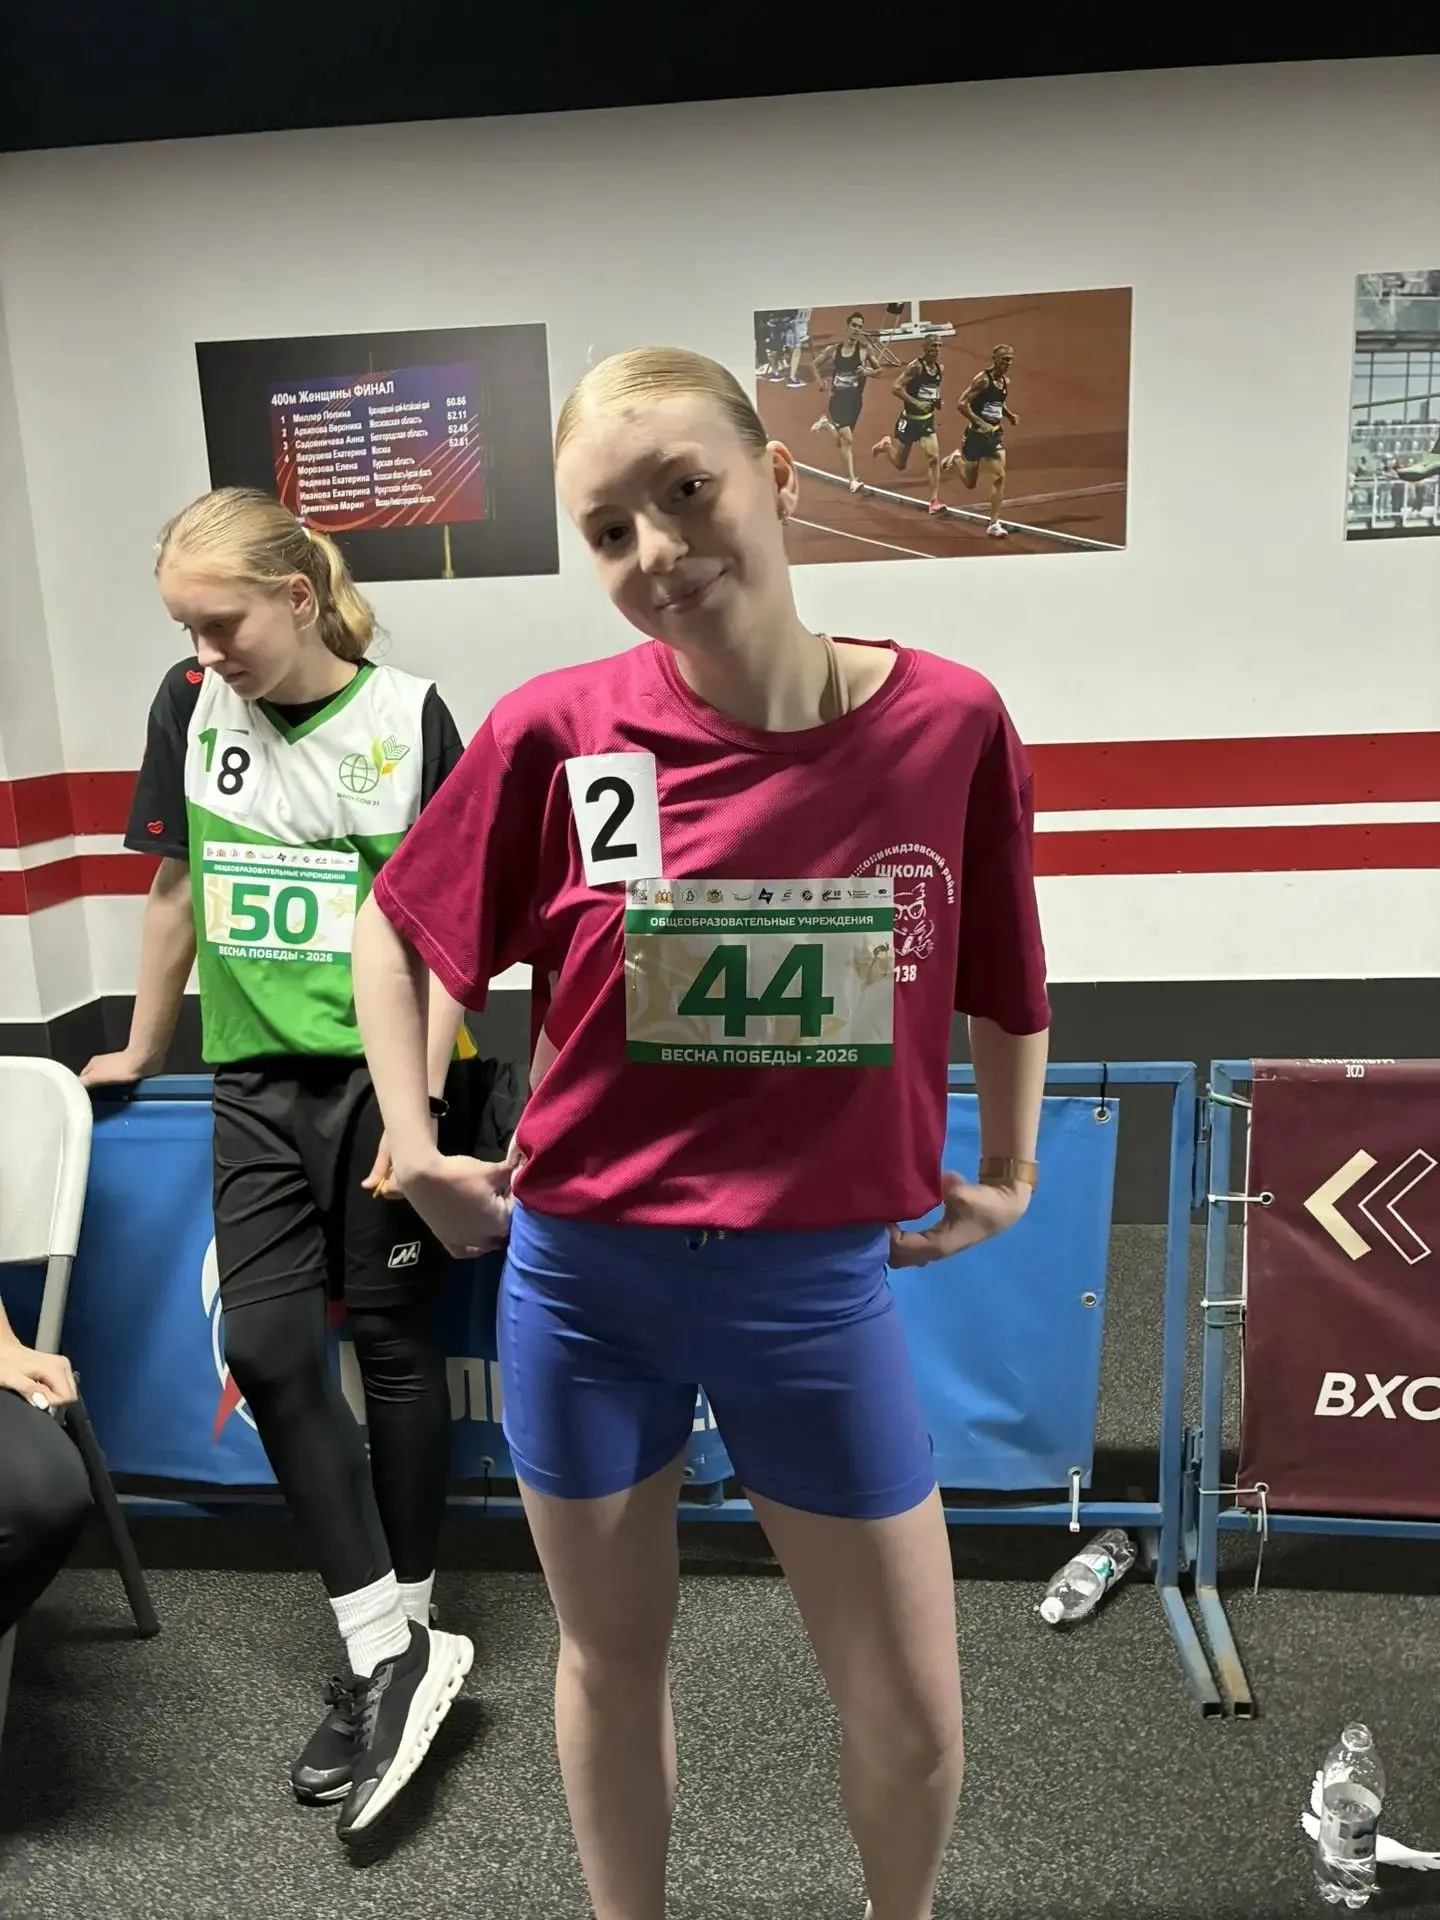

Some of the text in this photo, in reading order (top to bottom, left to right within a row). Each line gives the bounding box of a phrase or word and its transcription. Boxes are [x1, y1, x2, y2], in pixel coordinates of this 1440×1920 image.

[271, 380, 395, 407] 400м Женщины ФИНАЛ
[281, 429, 287, 438] 2
[327, 421, 362, 434] Вероника
[447, 411, 467, 421] 52.11
[292, 411, 322, 425] Миллер
[322, 408, 352, 421] Полина
[283, 442, 288, 451] 3
[284, 454, 290, 463] 4
[297, 463, 334, 477] Морозова
[335, 461, 359, 473] Елена
[332, 474, 370, 487] Екатерина
[300, 489, 331, 502] Иванова
[332, 487, 370, 500] Екатерина
[217, 746, 250, 795] 8
[585, 775, 638, 863] 2
[214, 863, 346, 881] ОБЩЕОБРАЗОВАТЕЛЬНЫЕ УЧРЕЖДЕНИЯ
[875, 864, 934, 878] ШКОЛА
[229, 882, 319, 945] 50
[650, 914, 874, 929] ОБЩЕОБРАЗОВАТЕЛЬНЫЕ УЧРЕЖДЕНИЯ
[219, 945, 247, 958] ВЕСНА
[248, 947, 298, 961] ПОБЕДЫ
[306, 951, 333, 963] 2026
[893, 964, 917, 982] 138
[677, 943, 835, 1038] 44
[661, 1047, 718, 1063] ВЕСНА
[722, 1048, 801, 1065] ПОБЕДЫ
[816, 1047, 859, 1063] 2026
